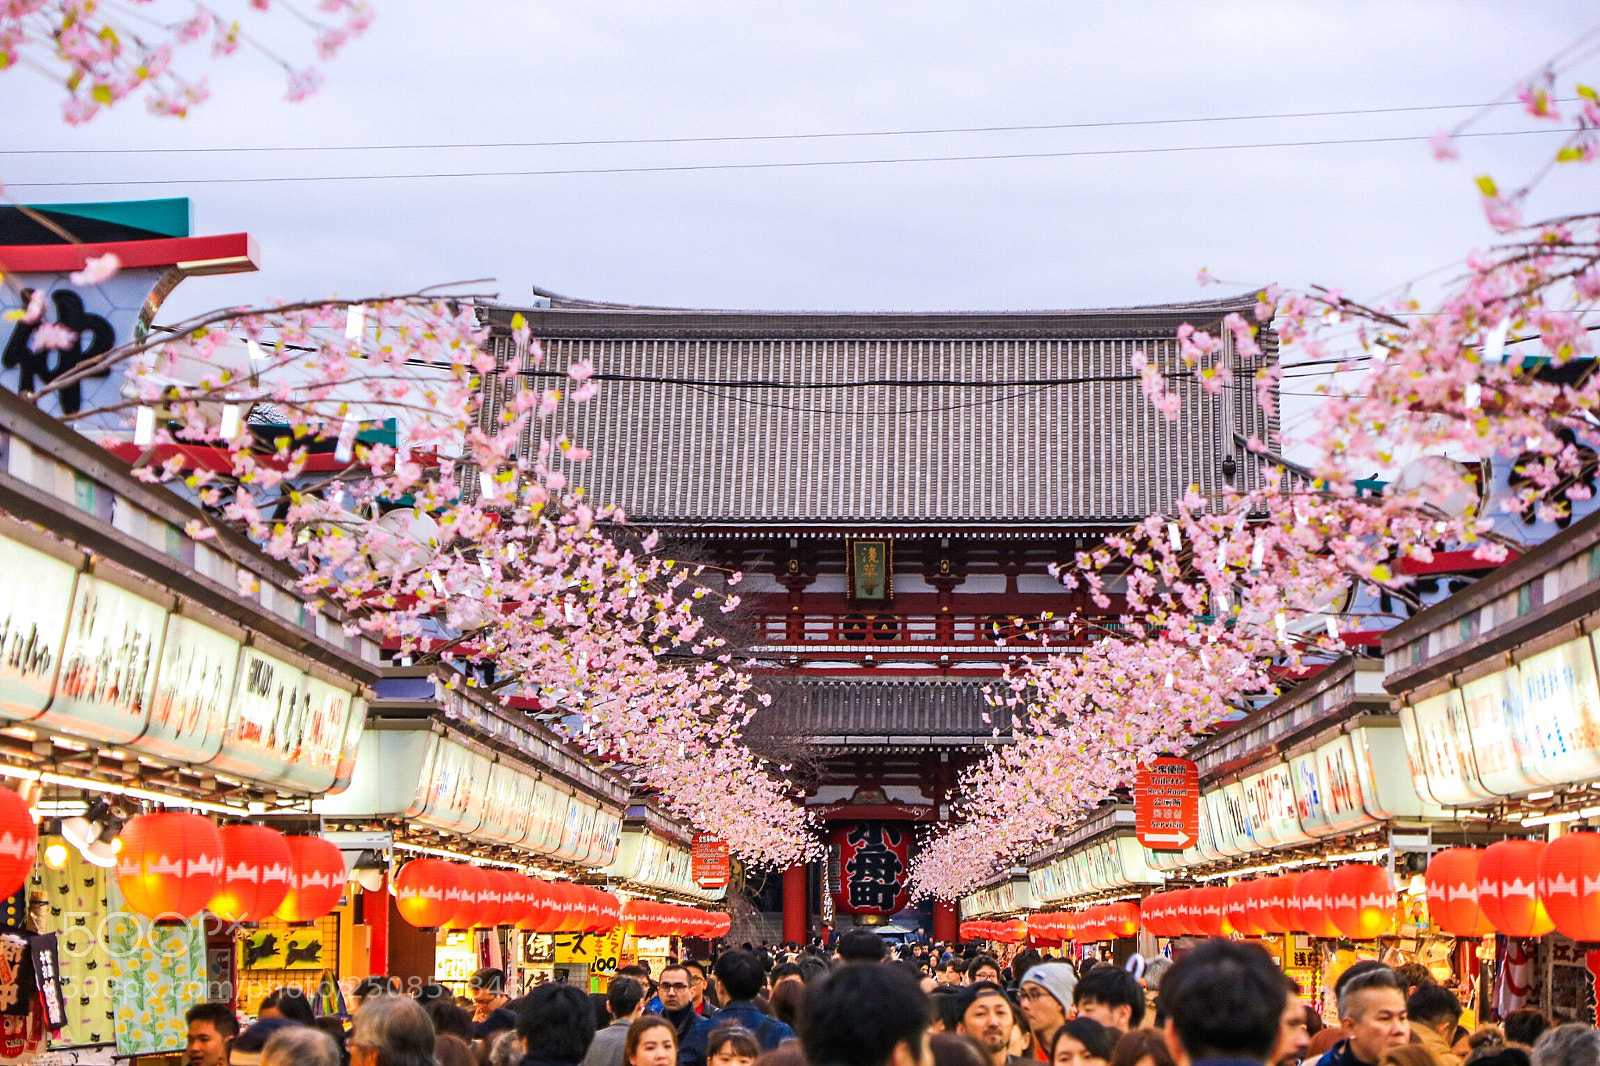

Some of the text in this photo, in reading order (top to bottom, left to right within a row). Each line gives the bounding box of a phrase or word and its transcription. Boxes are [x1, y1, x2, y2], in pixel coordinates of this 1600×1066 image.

[1150, 777, 1185, 785] Toilette
[1147, 787, 1187, 796] Rest Room
[1151, 820, 1184, 829] Servicio
[846, 822, 903, 911] 小舟町
